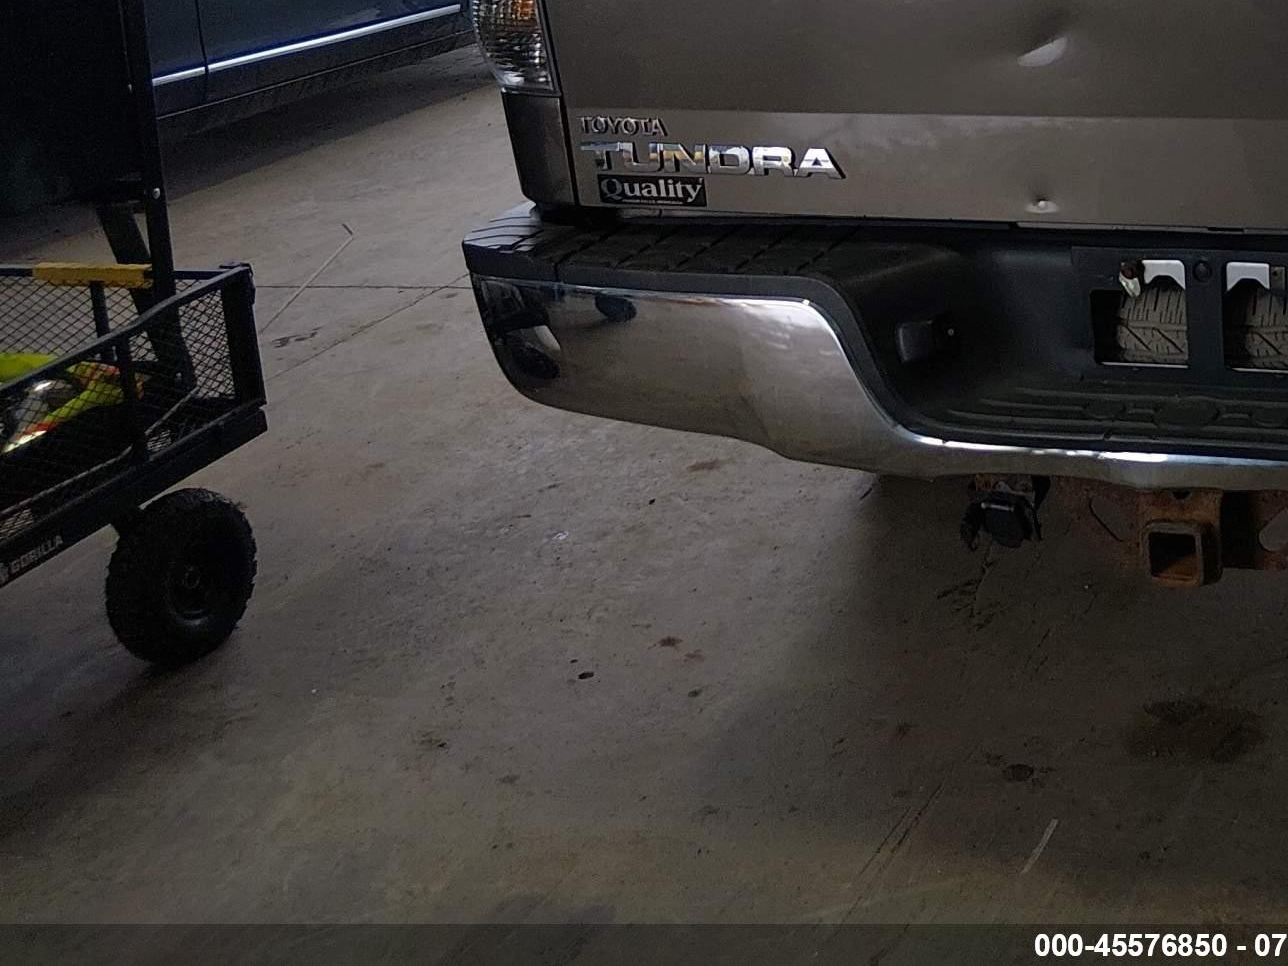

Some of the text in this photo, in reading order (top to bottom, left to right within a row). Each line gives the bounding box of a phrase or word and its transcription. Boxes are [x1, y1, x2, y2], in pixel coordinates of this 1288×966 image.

[581, 116, 668, 136] TOYOTA
[580, 141, 847, 179] TUNDRA
[600, 178, 703, 203] Quality
